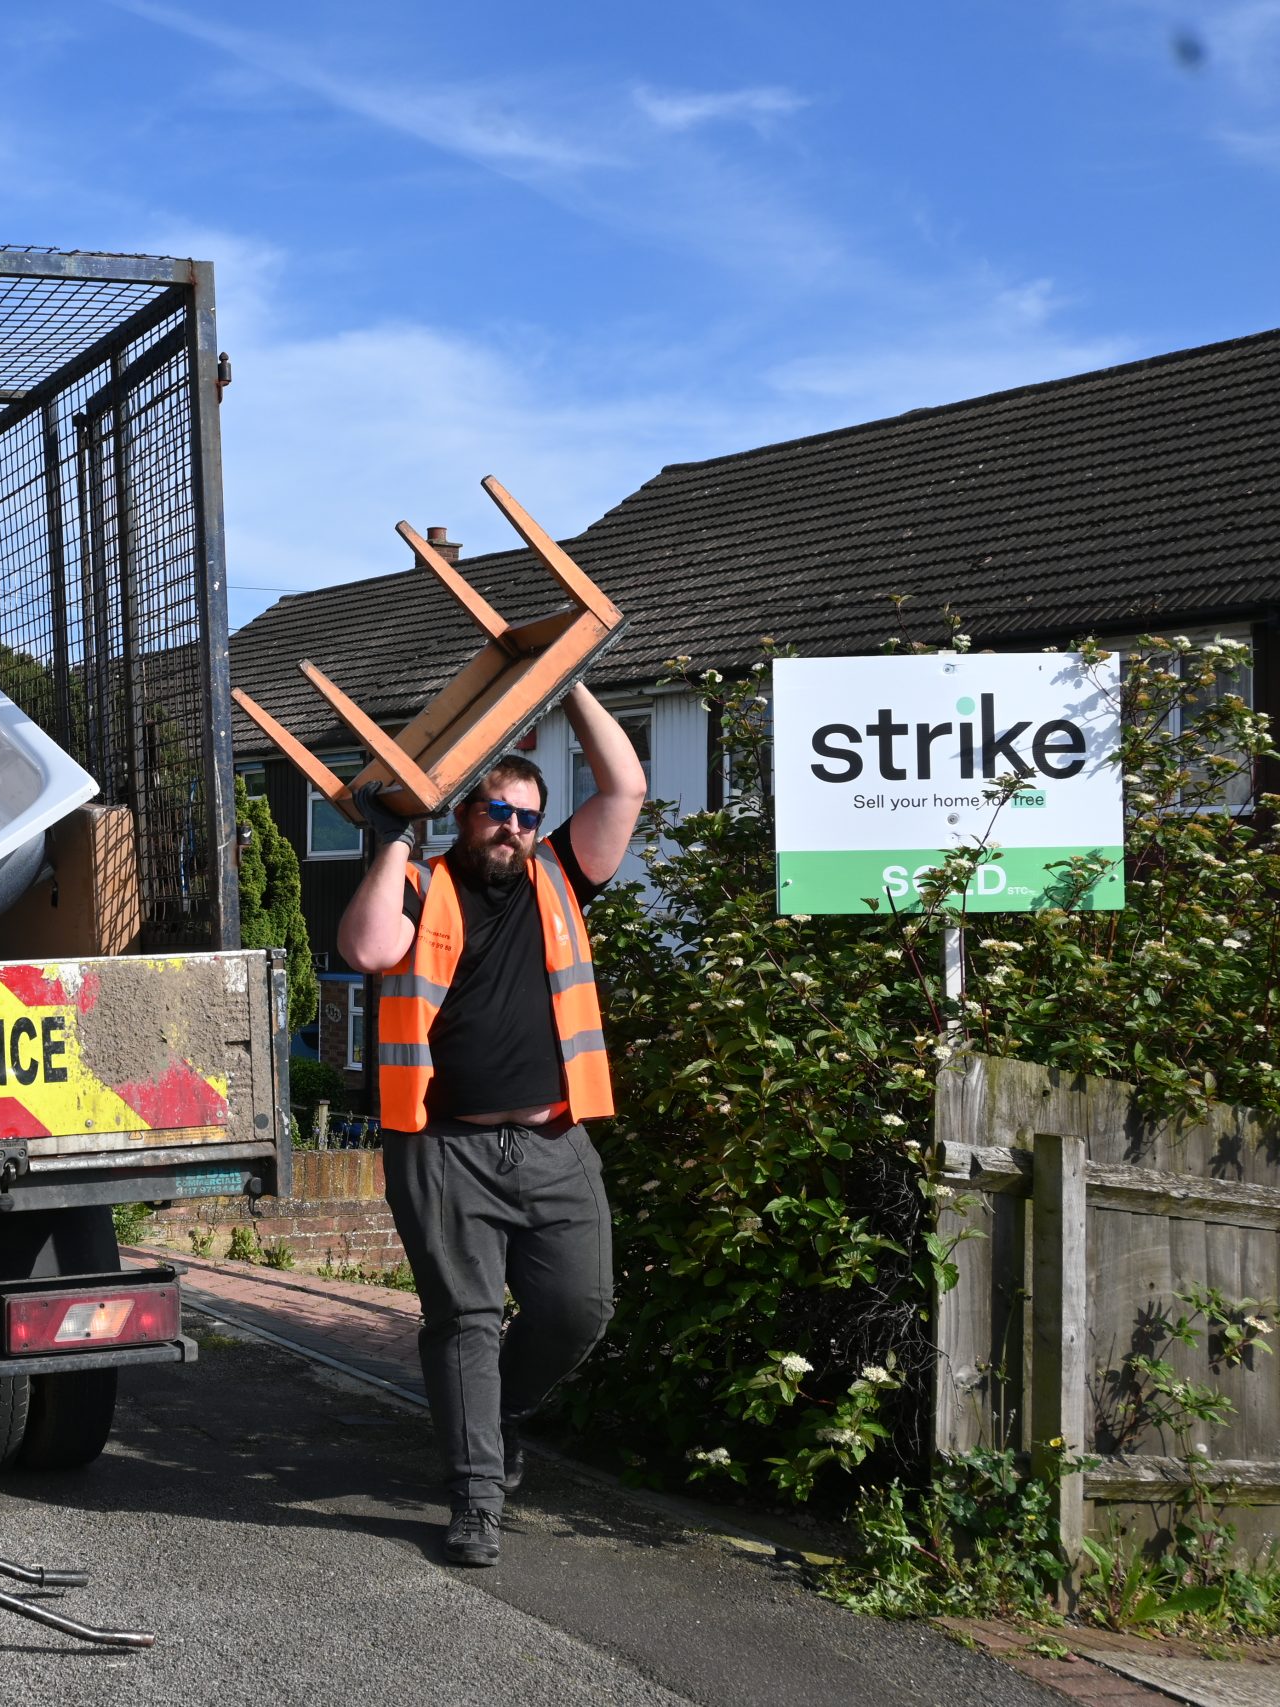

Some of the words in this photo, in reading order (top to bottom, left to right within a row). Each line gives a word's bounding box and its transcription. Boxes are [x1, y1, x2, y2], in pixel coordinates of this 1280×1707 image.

[810, 693, 1086, 783] strike
[853, 794, 884, 809] Sell
[890, 797, 929, 811] your
[933, 793, 980, 809] home
